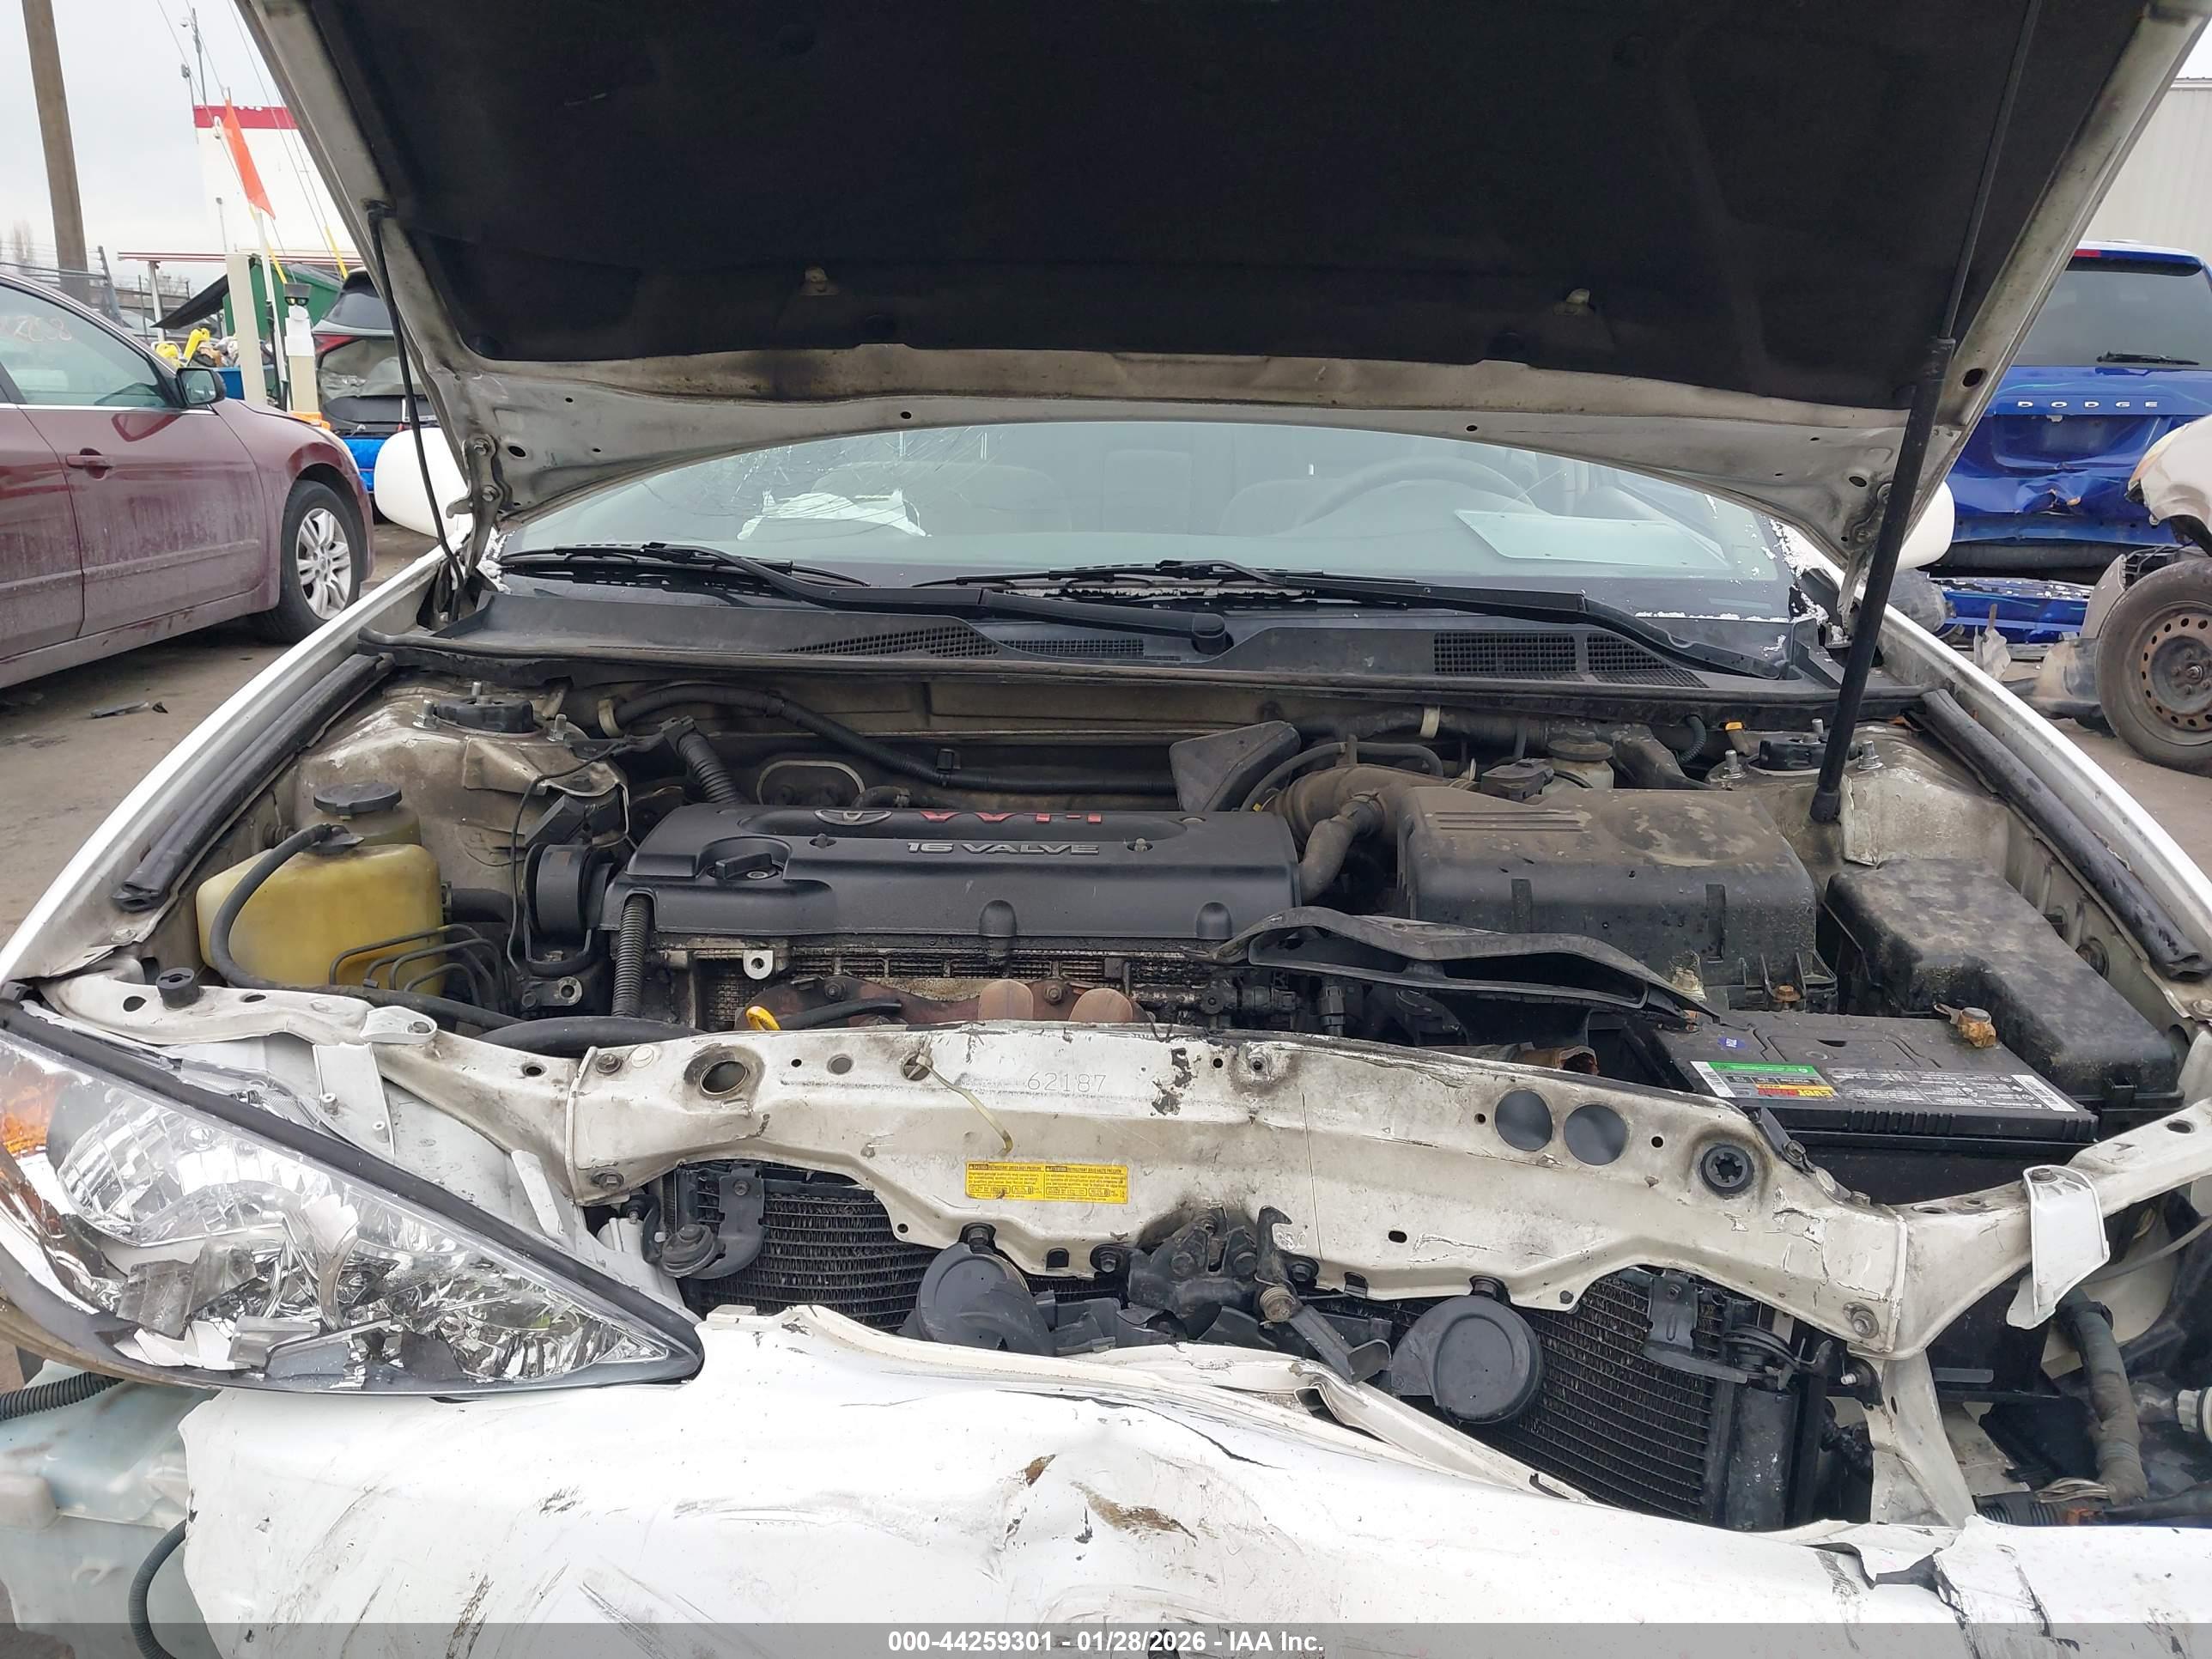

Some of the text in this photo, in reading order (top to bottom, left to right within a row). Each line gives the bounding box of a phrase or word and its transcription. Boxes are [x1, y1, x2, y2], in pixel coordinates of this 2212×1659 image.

[2017, 400, 2158, 409] DODGE
[907, 842, 1101, 855] 16 VALVE
[1027, 1071, 1107, 1093] 62187
